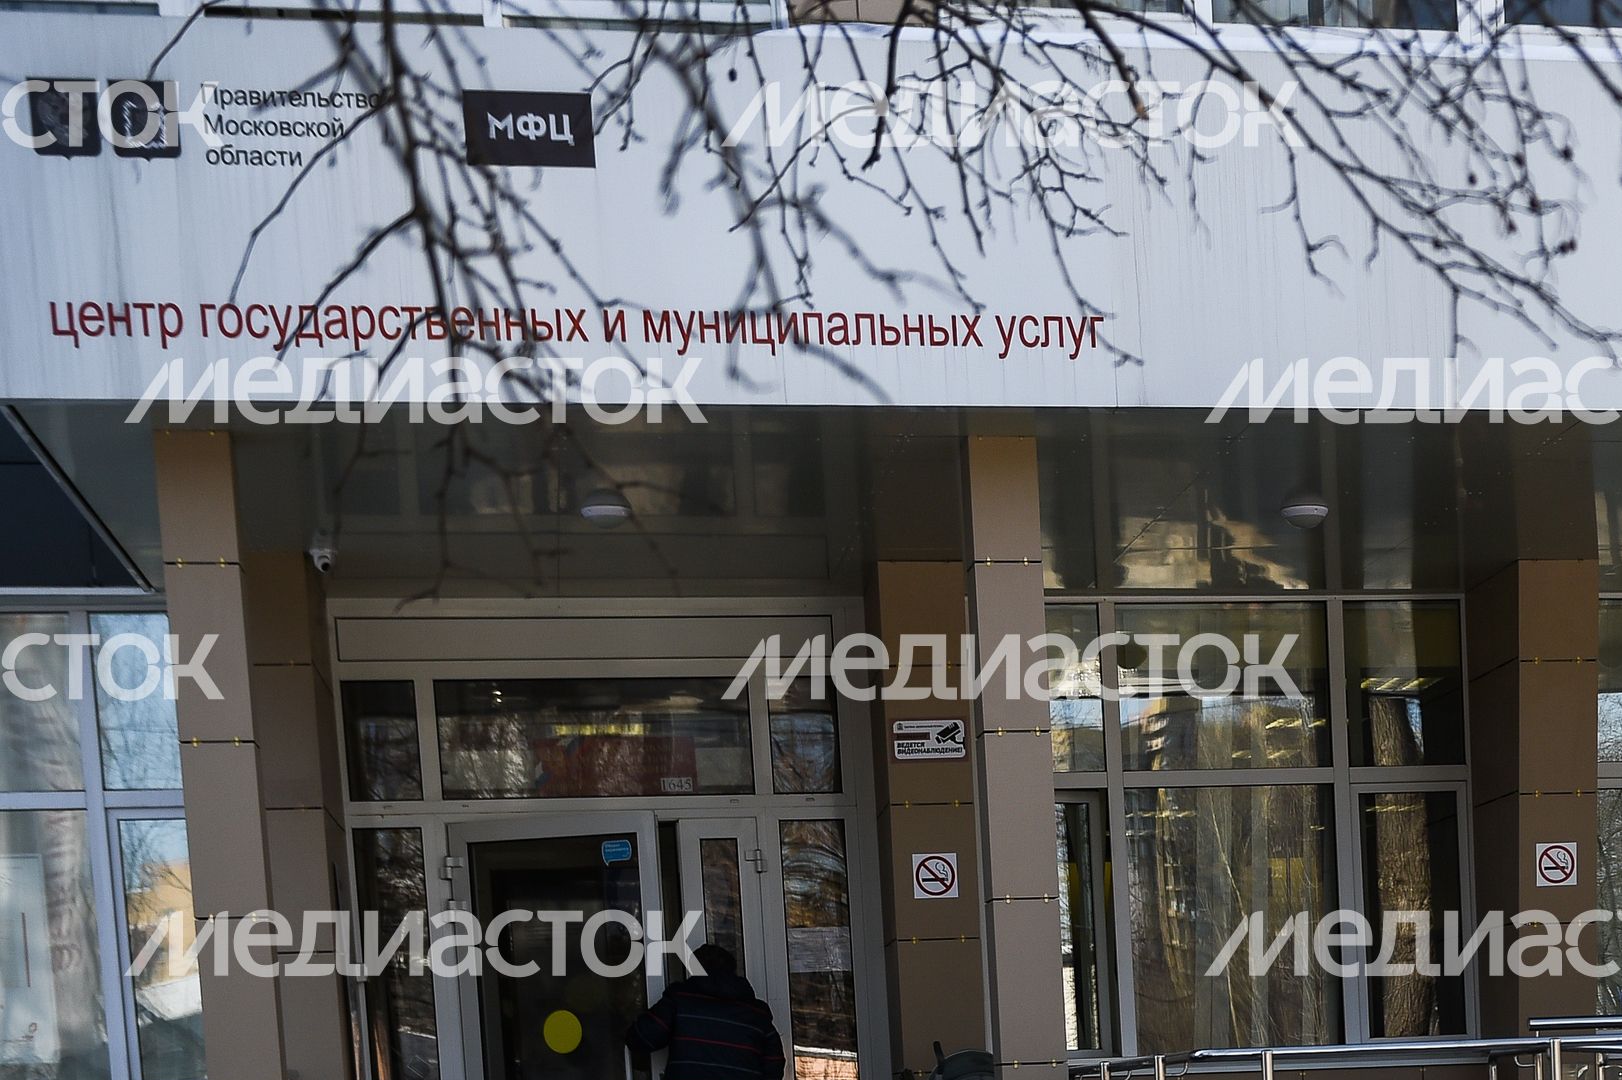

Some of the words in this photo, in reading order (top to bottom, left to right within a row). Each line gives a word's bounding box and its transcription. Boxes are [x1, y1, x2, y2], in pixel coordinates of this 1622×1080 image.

[200, 82, 382, 110] Правительство
[203, 114, 345, 138] Московской
[486, 111, 575, 146] МФЦ
[206, 144, 303, 166] области
[49, 300, 184, 349] центр
[199, 301, 590, 351] государственных
[603, 309, 628, 344] и
[642, 309, 984, 357] муниципальных
[996, 313, 1105, 360] услуг
[661, 778, 693, 792] 1645
